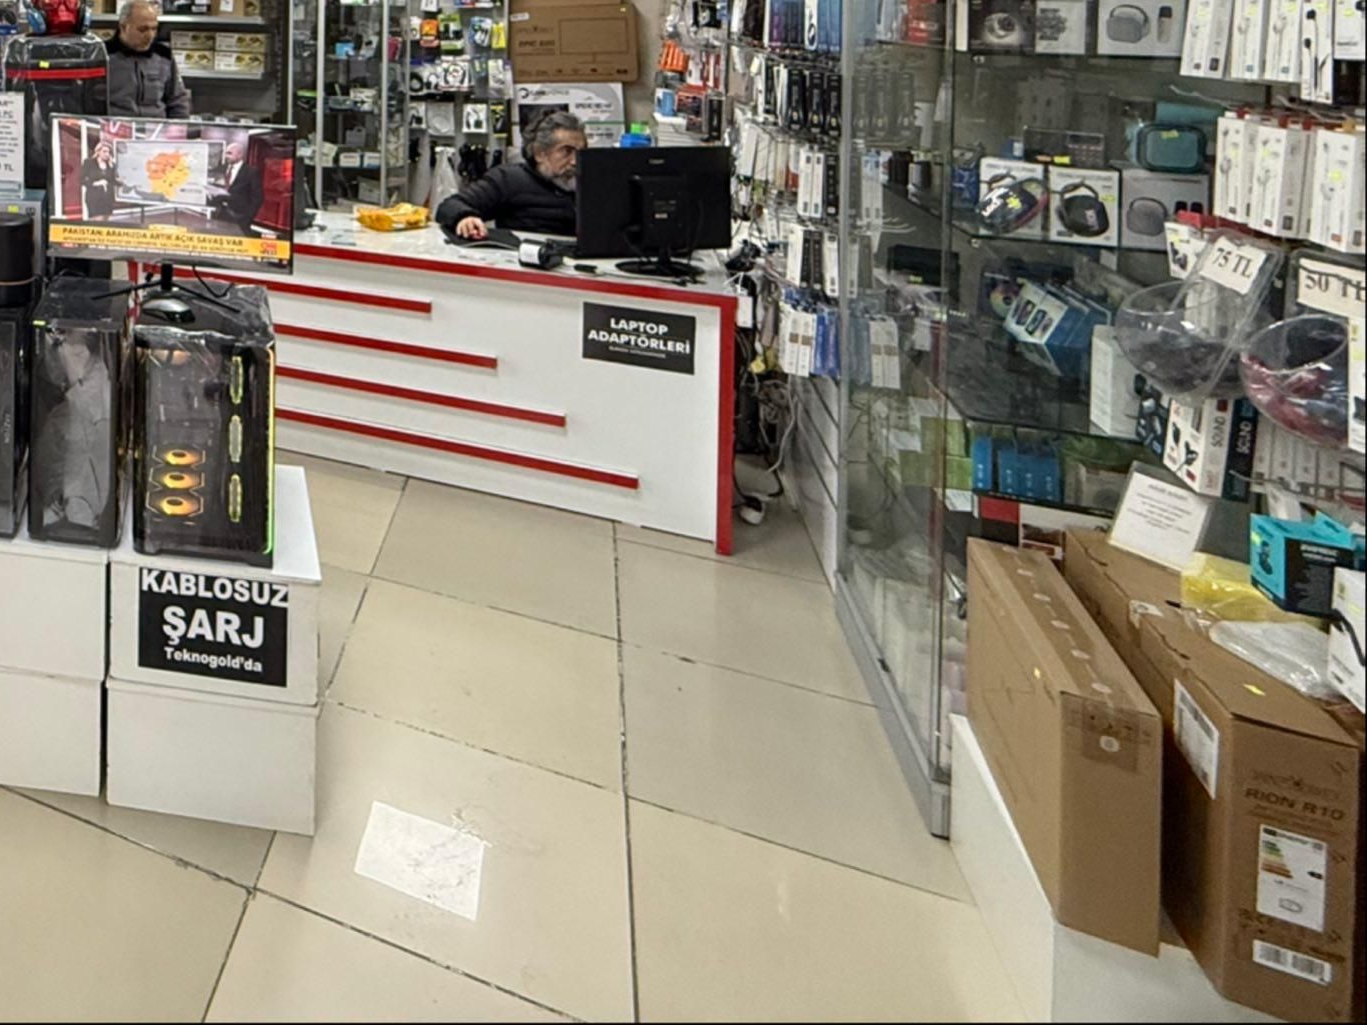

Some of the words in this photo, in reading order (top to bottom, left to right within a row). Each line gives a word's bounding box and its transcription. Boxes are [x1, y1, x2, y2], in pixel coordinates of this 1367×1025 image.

[1211, 246, 1230, 269] 75
[1230, 254, 1253, 279] TL
[610, 317, 669, 335] LAPTOP
[587, 329, 691, 355] ADAPTÖRLERİ
[141, 567, 290, 609] KABLOSUZ
[162, 604, 265, 650] ŞARJ
[163, 645, 264, 673] Teknogold'da
